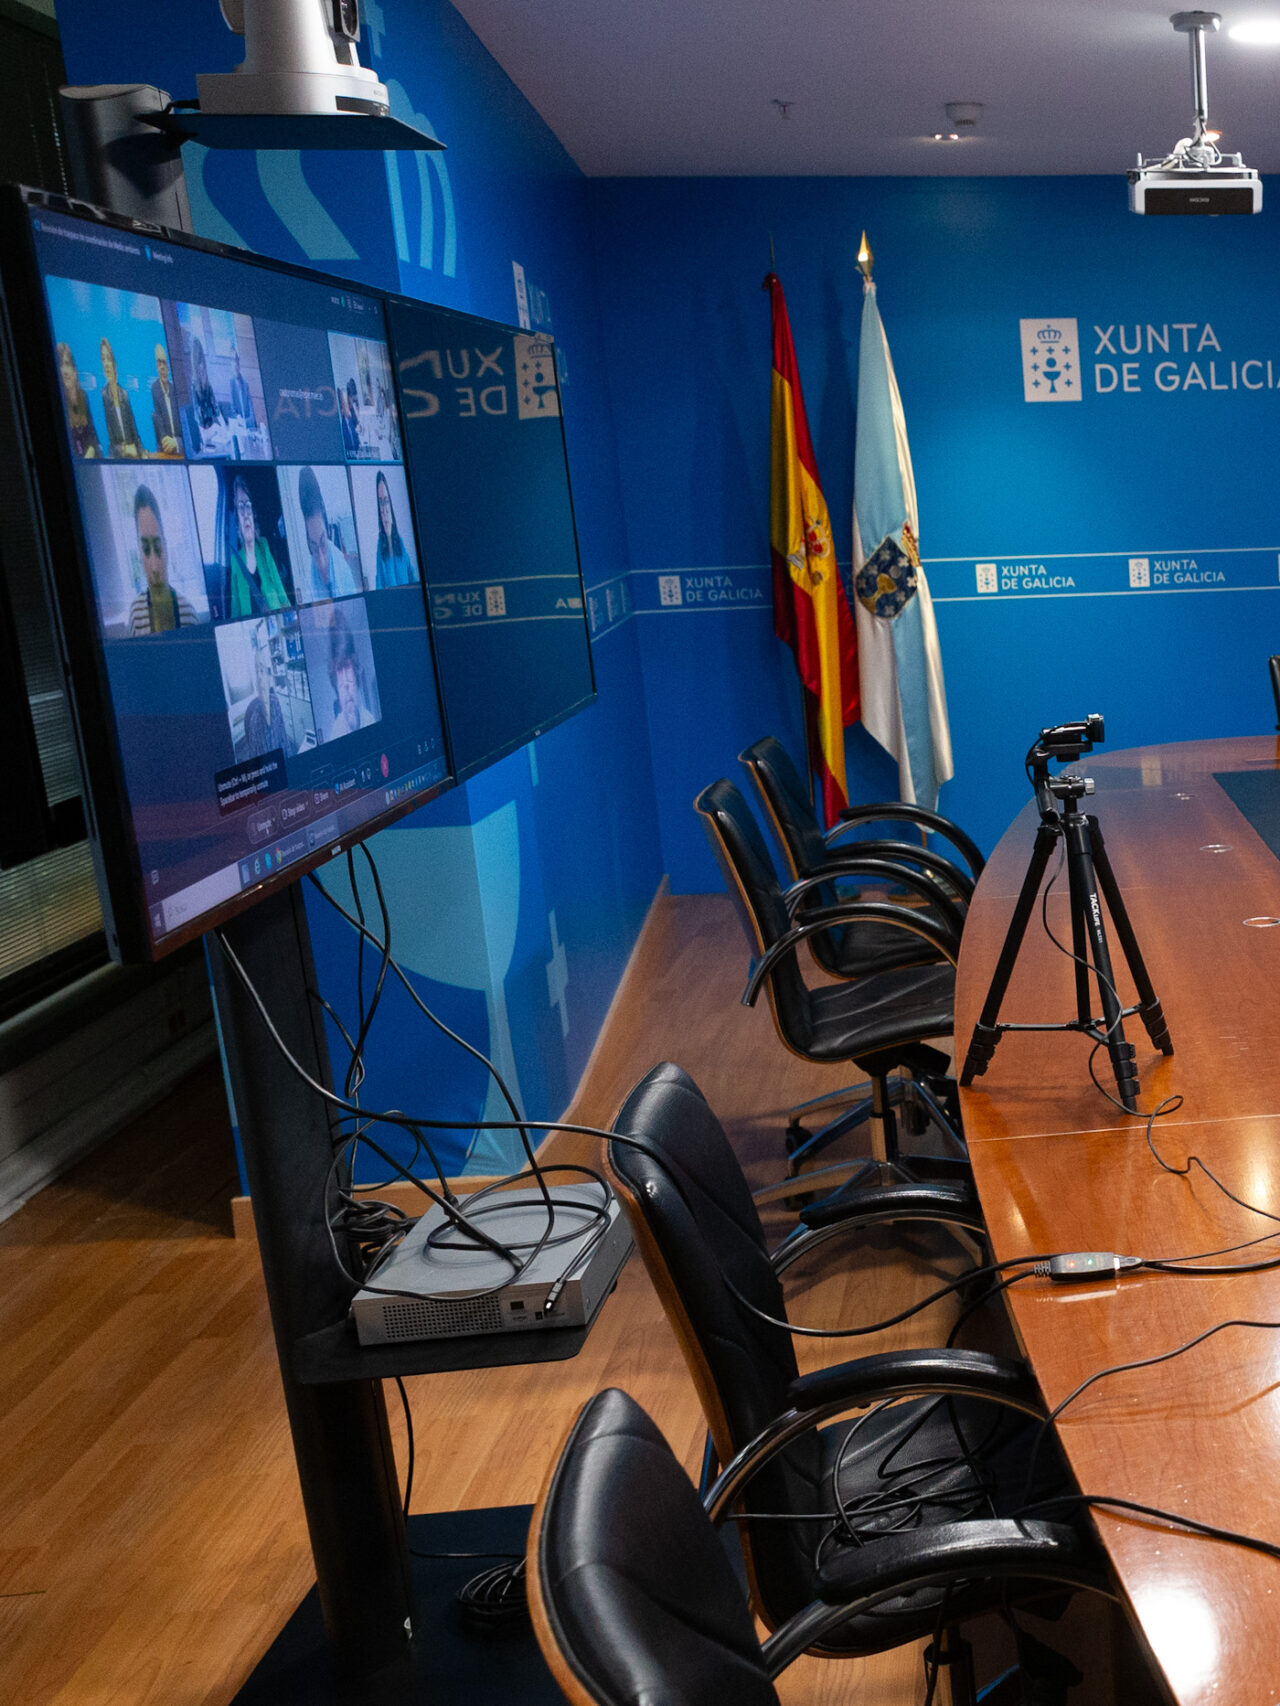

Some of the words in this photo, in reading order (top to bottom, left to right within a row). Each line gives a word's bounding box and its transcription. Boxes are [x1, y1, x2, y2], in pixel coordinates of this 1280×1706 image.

[1093, 323, 1222, 355] XUNTA
[1094, 362, 1141, 393] DE
[1001, 564, 1047, 577] XUNTA
[1153, 559, 1198, 572] XUNTA
[685, 576, 733, 588] XUNTA
[1001, 578, 1019, 590] DE
[1022, 576, 1076, 589] GALICIA
[1153, 573, 1172, 585] DE
[1173, 570, 1226, 584] GALICIA
[685, 589, 705, 602] DE
[707, 587, 764, 601] GALICIA
[1089, 892, 1101, 927] TACKLIFE
